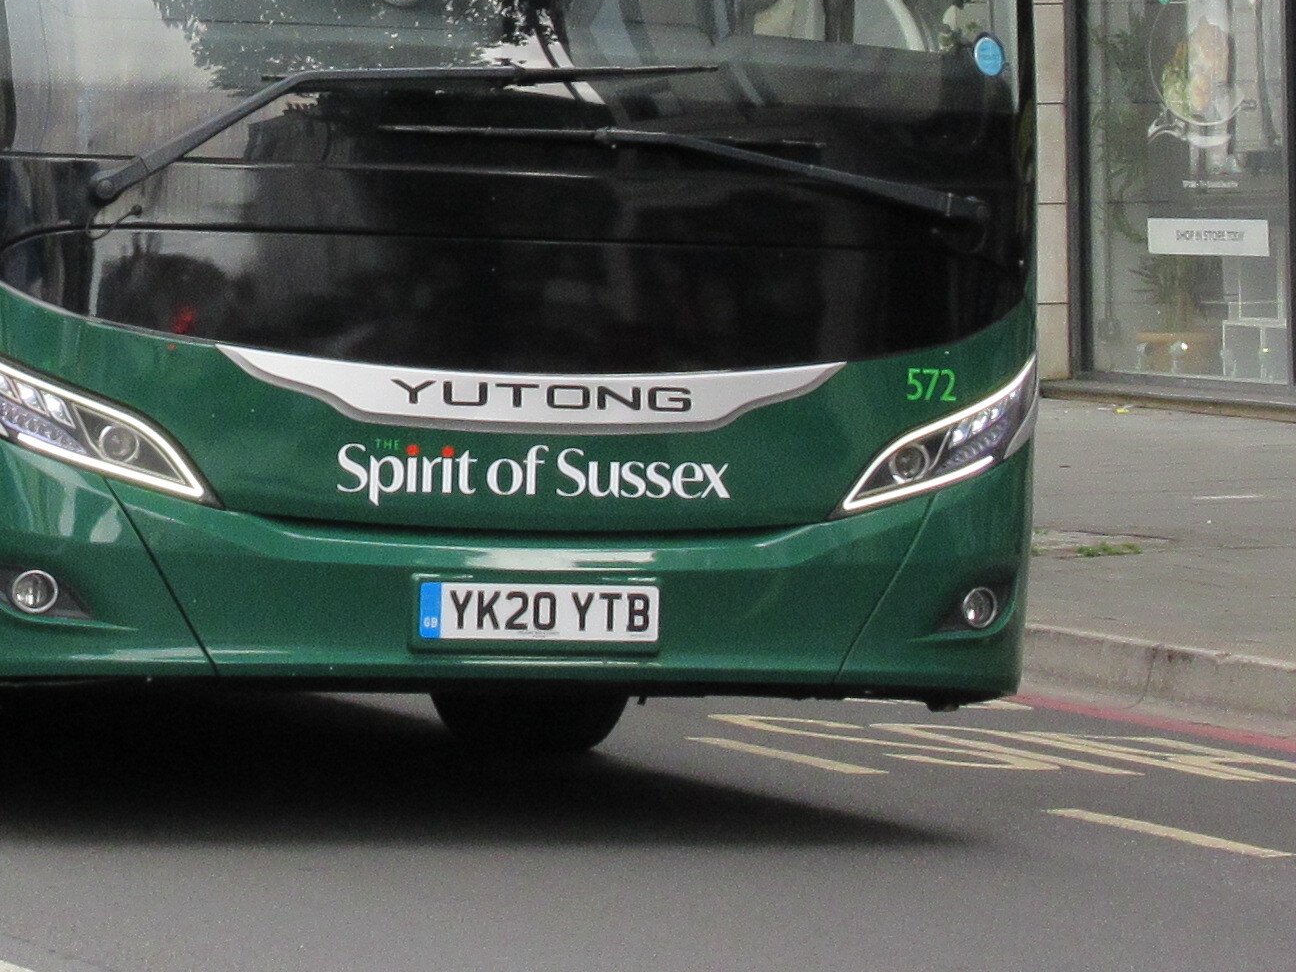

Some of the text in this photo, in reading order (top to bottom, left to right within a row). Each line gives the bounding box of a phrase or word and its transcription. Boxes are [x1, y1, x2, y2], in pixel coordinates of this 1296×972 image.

[391, 377, 694, 414] YUTONG
[906, 368, 958, 404] 572
[375, 439, 401, 451] THE
[336, 442, 731, 506] Spirit of Sussex
[423, 617, 438, 628] GB
[449, 589, 650, 633] YK20 YTB
